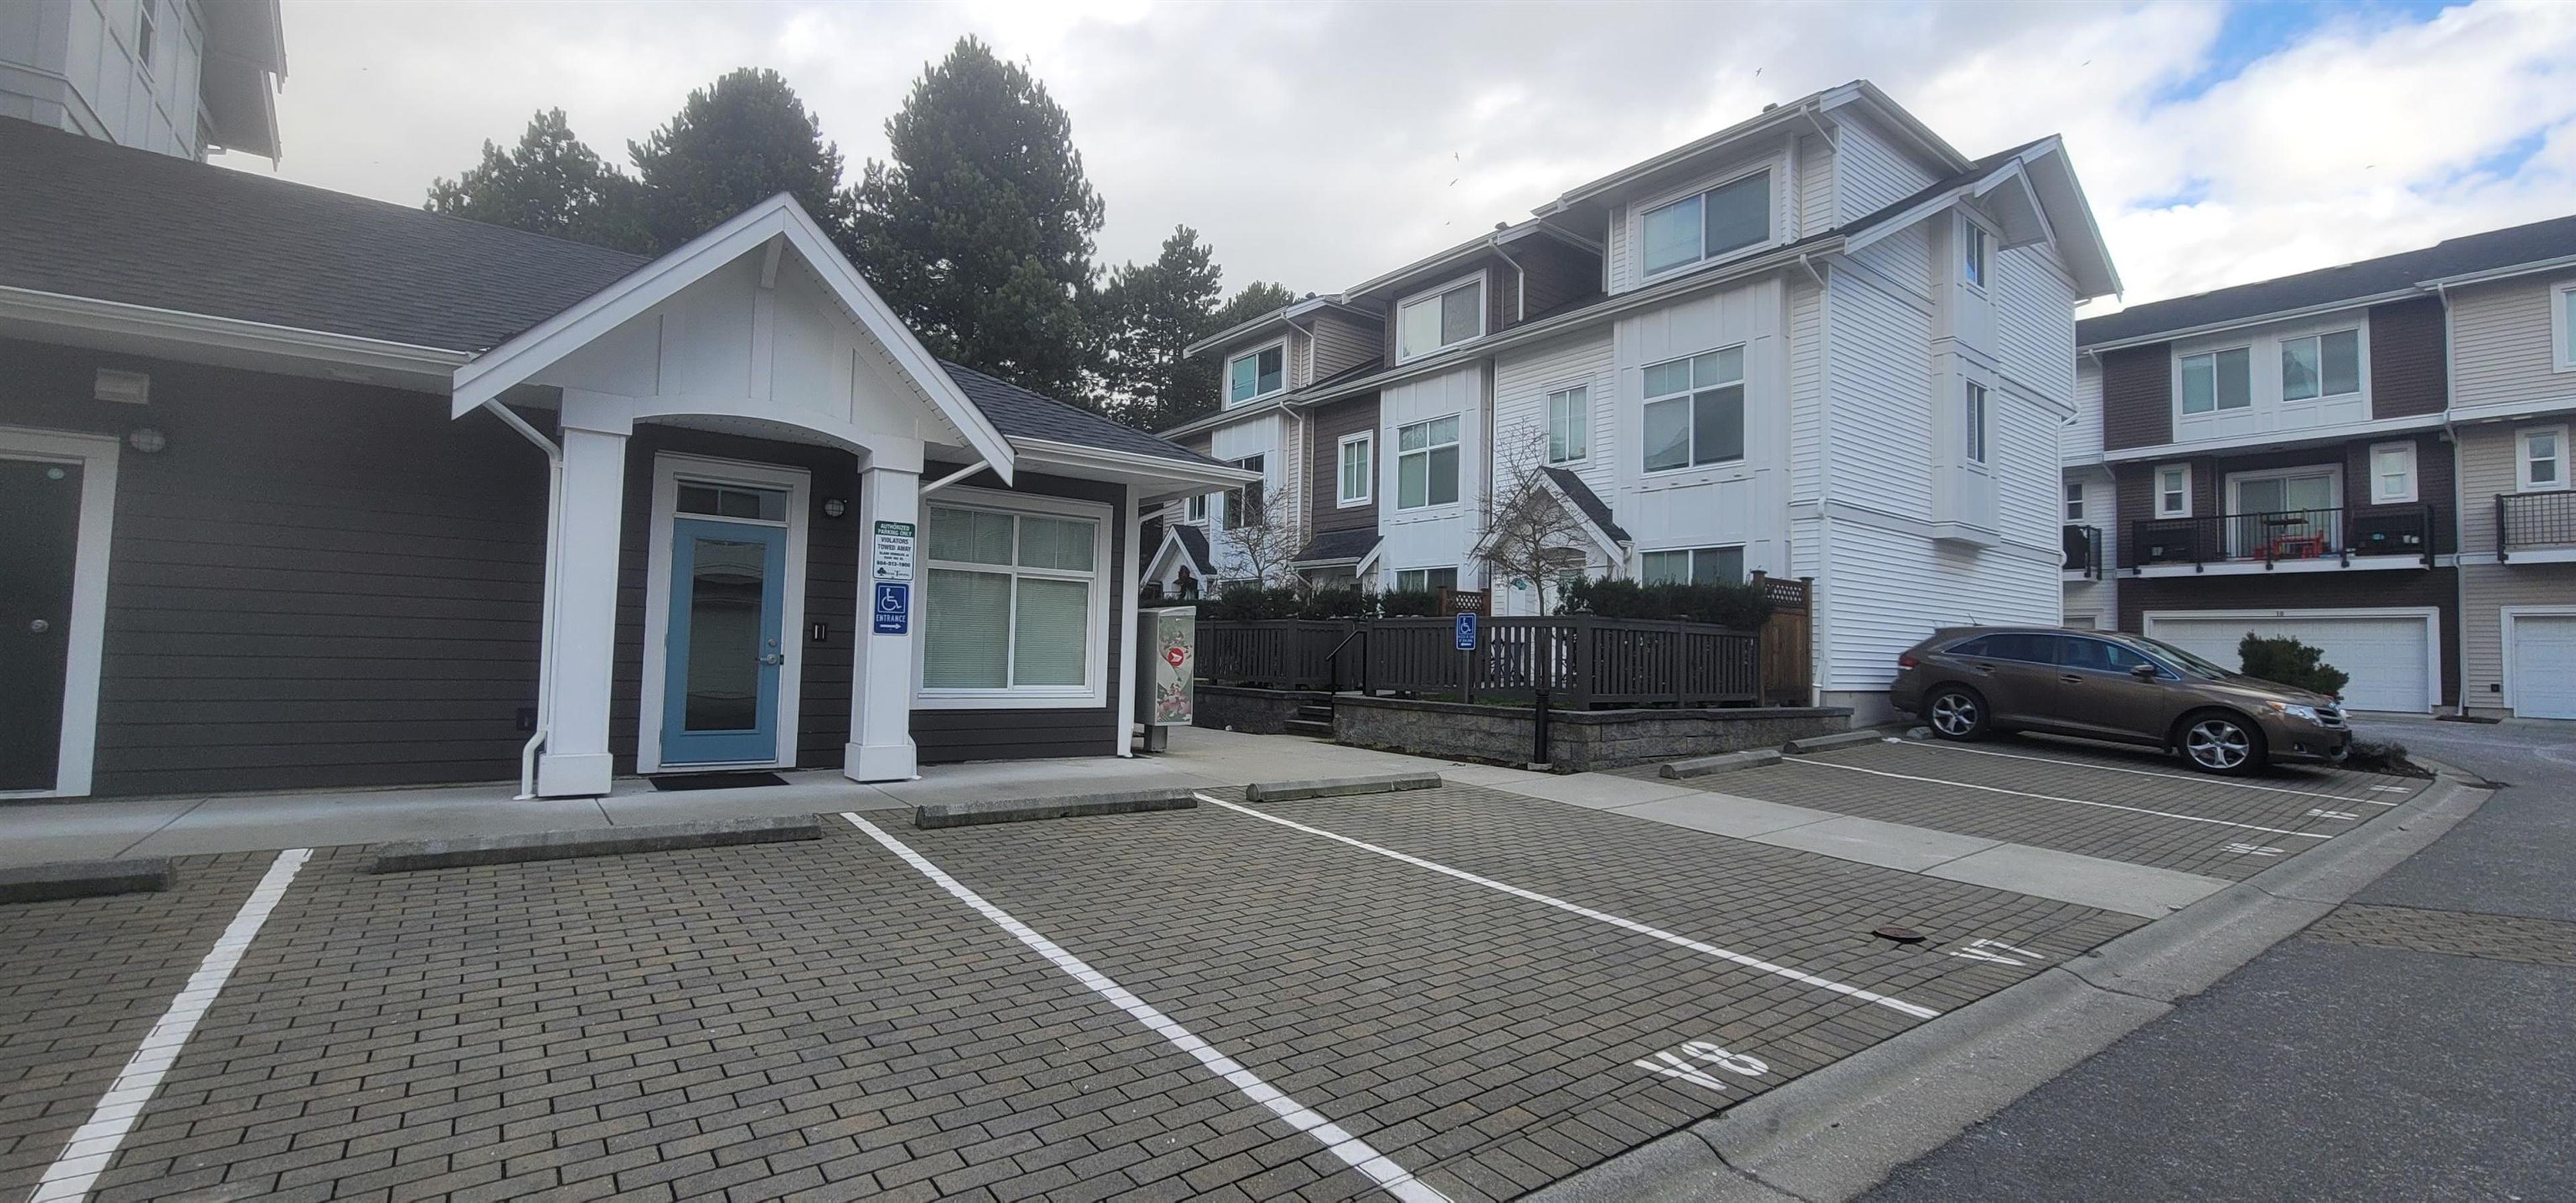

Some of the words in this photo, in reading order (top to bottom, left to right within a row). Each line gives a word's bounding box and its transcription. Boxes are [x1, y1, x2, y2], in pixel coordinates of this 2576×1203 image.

[880, 523, 910, 531] AUTHORIZED
[880, 537, 909, 545] VIOLATORS
[876, 614, 906, 623] ENTRANCE
[1949, 939, 2045, 966] V7
[1633, 1041, 1769, 1091] V8
